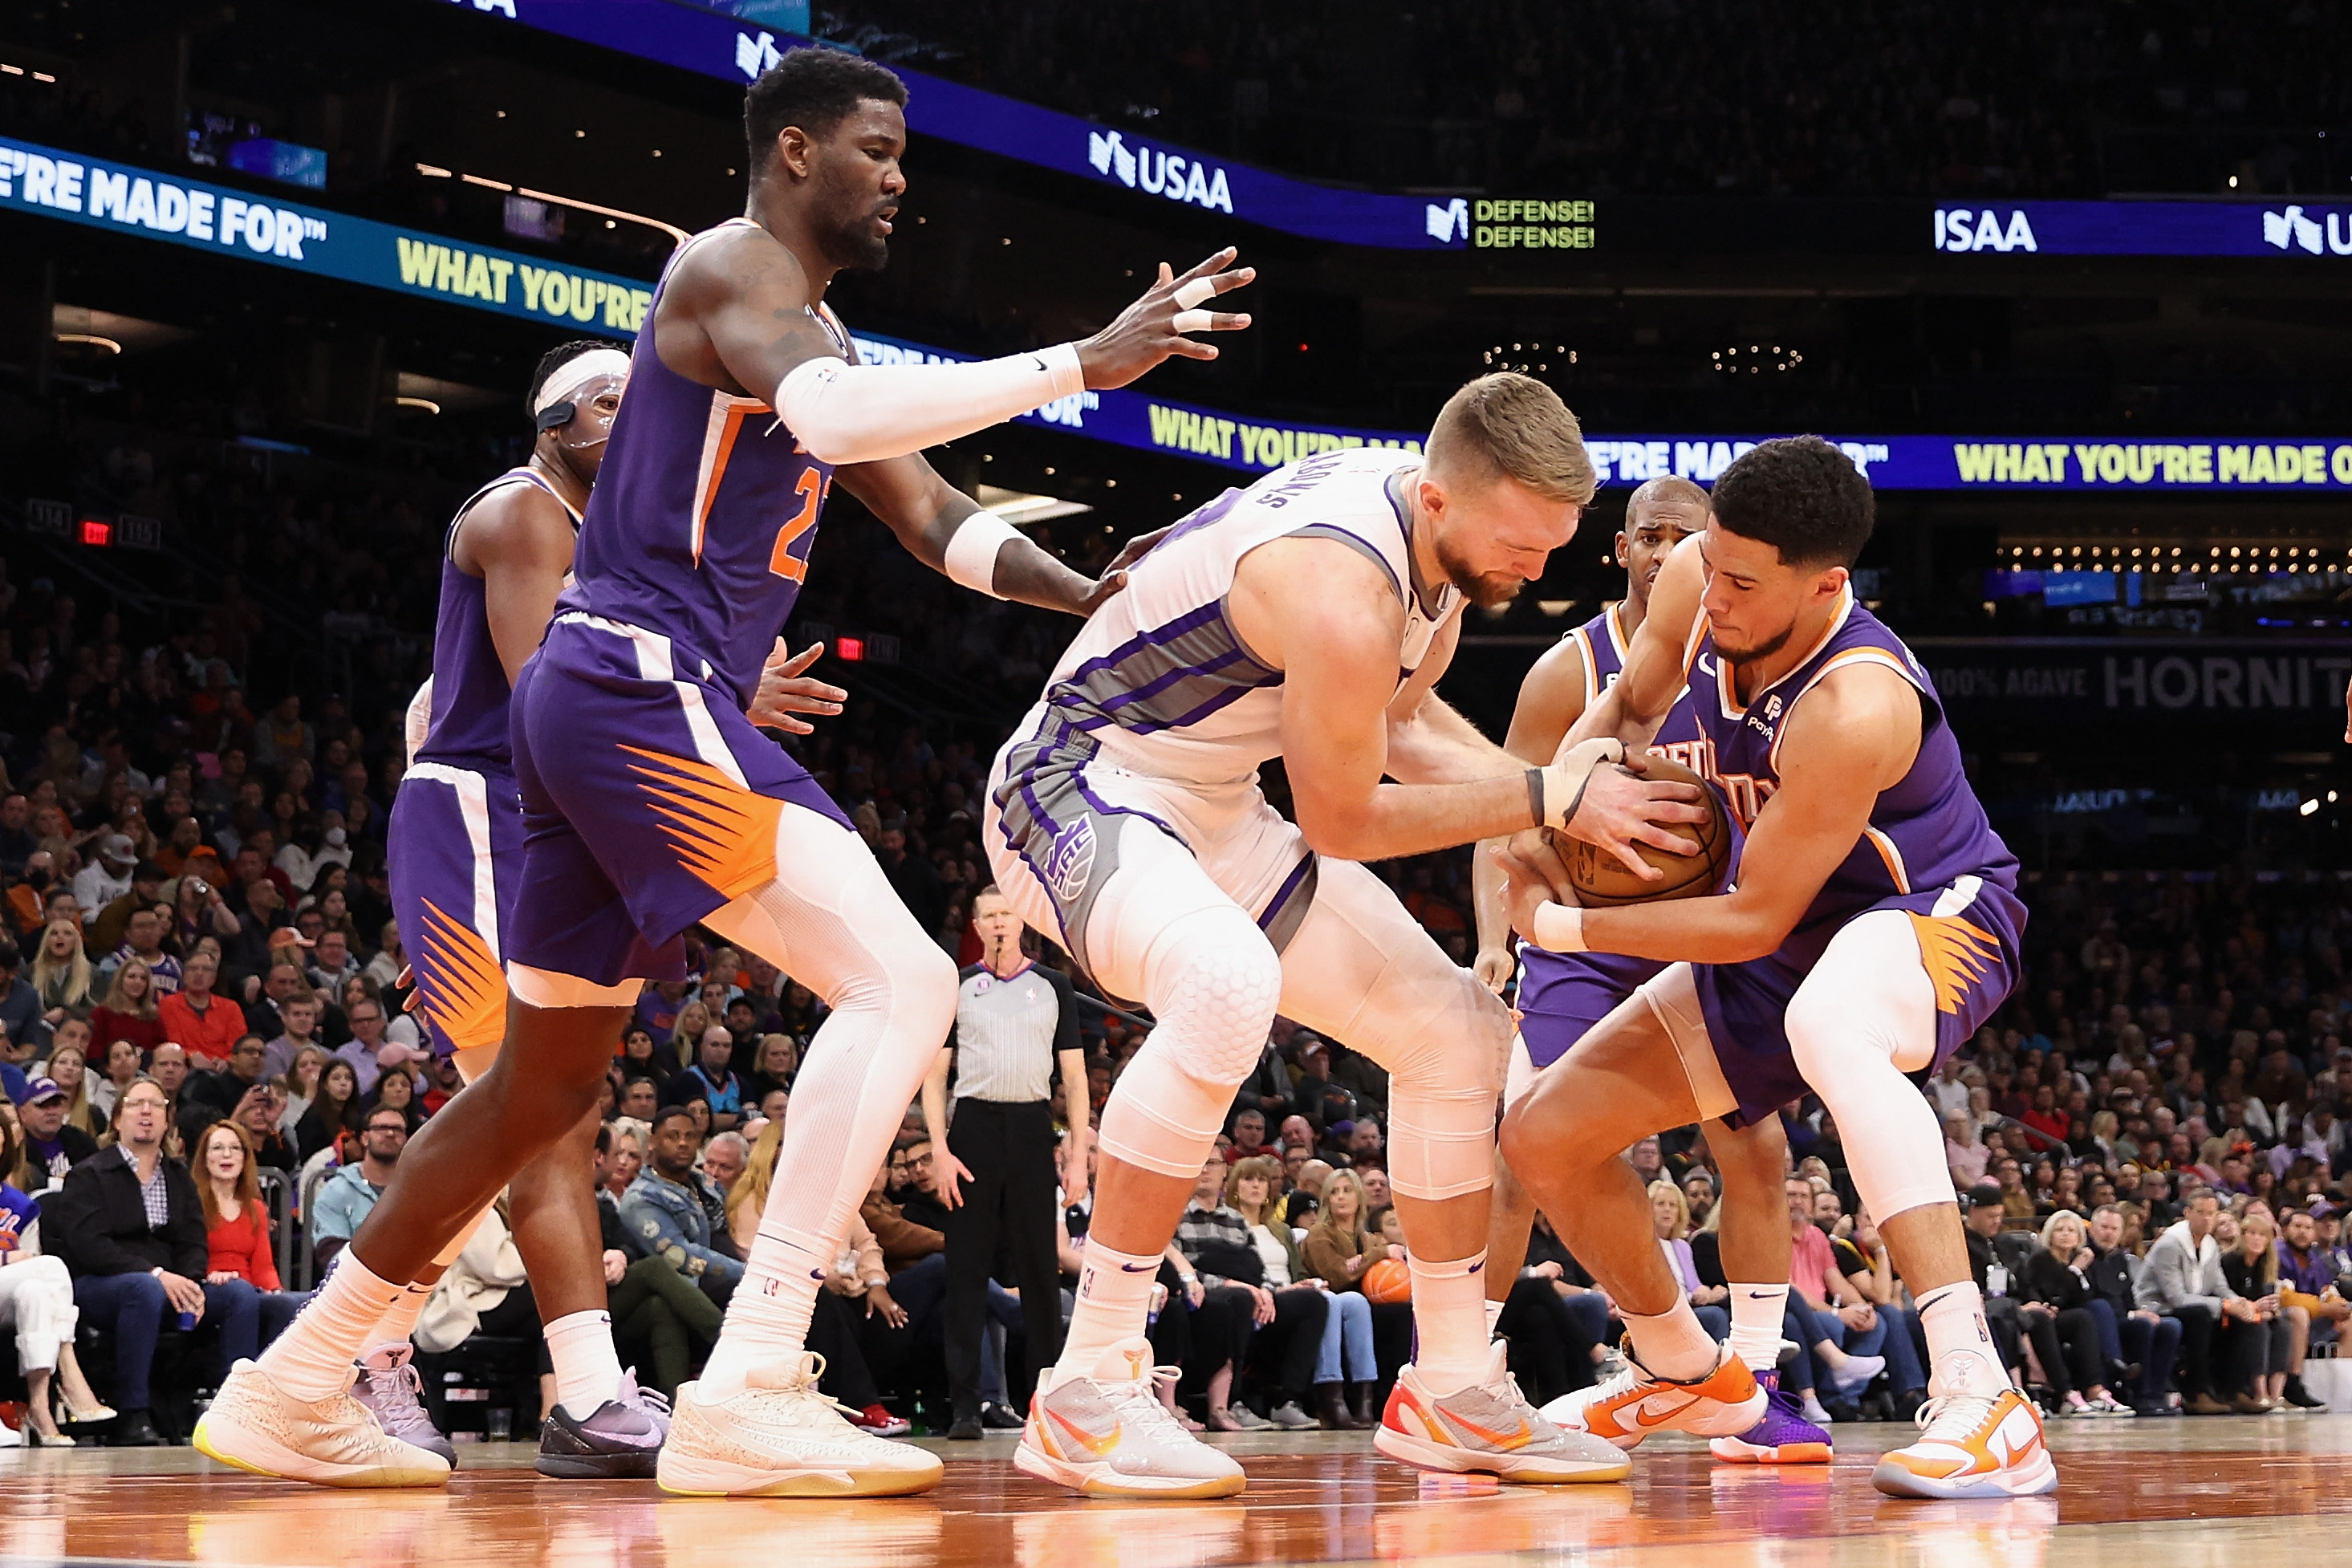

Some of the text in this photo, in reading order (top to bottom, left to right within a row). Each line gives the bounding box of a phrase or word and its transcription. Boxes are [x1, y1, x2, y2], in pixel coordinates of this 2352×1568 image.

[89, 167, 215, 241] MADE
[1138, 146, 1234, 215] USAA
[1474, 200, 1594, 222] DEFENSE!
[1474, 225, 1594, 248] DEFENSE!
[397, 238, 652, 332] WHAT YOU'RE
[1148, 404, 1236, 460] WHAT
[1582, 442, 1670, 481] E'RE
[1953, 444, 2070, 482] WHAT
[2074, 444, 2214, 483] YOU'RE
[2217, 445, 2327, 483] MADE
[769, 466, 832, 585] 2
[2007, 668, 2087, 696] AGAVE
[2104, 656, 2351, 708] HORNIT
[1747, 716, 1774, 743] PayPa
